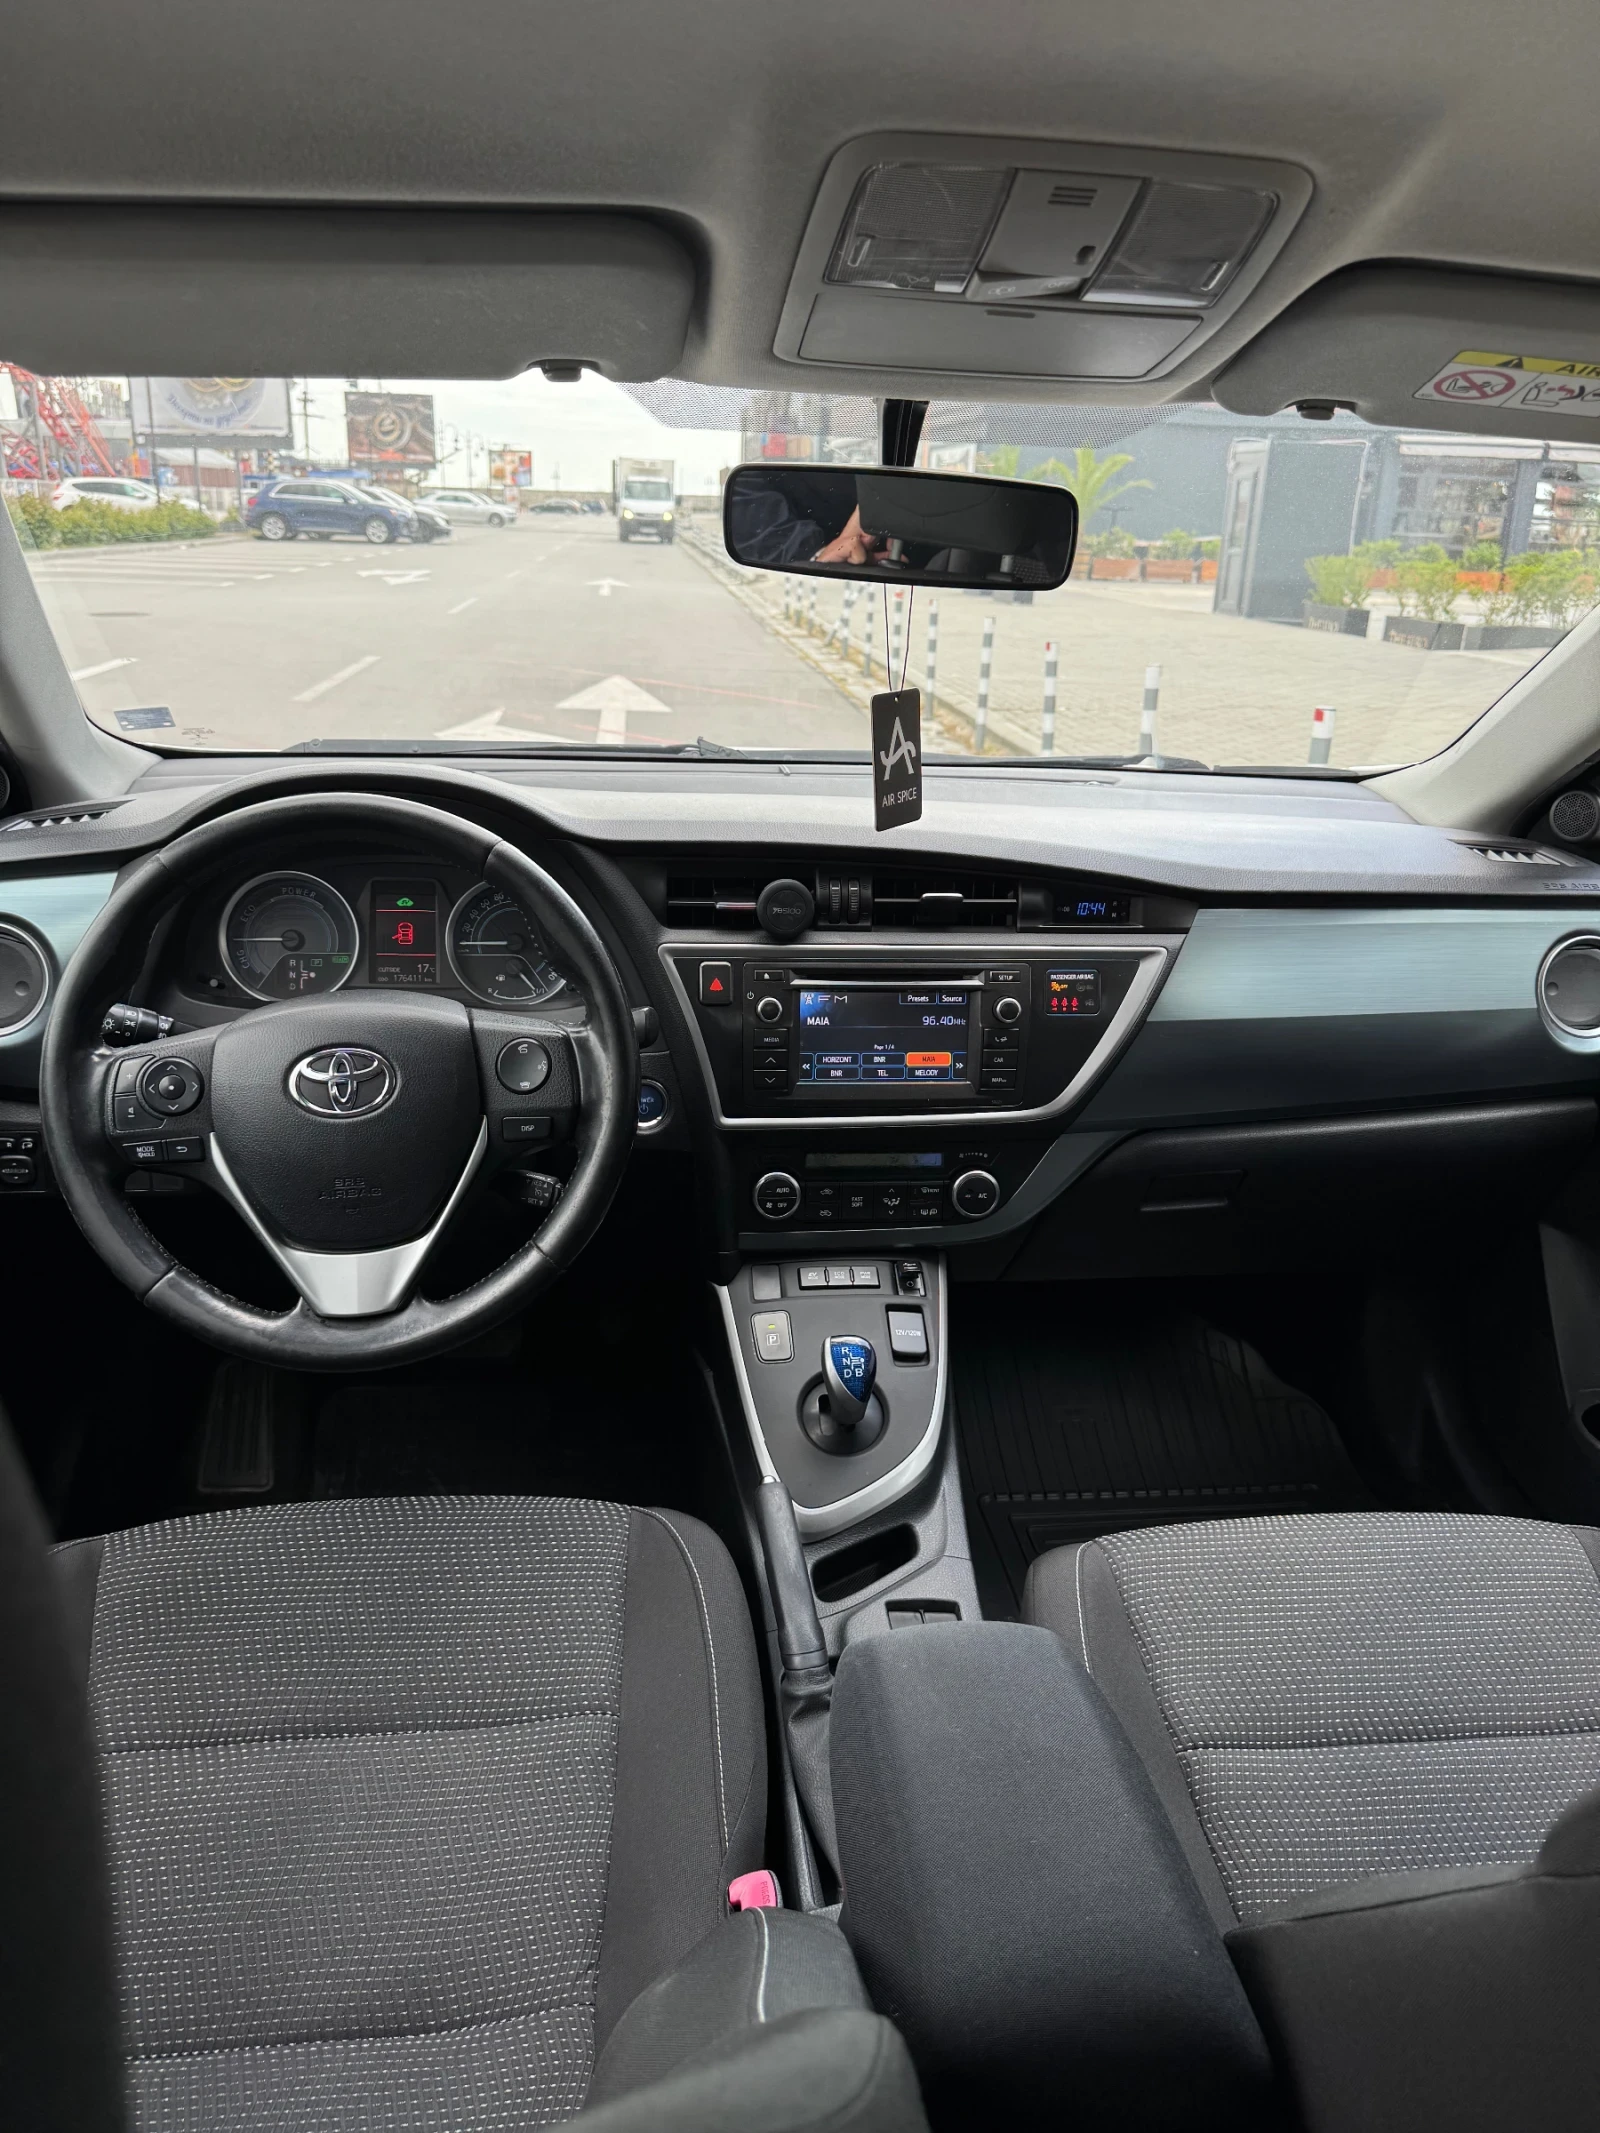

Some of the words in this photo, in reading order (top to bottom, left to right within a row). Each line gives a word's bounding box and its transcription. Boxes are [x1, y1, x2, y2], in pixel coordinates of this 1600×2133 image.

[882, 794, 895, 807] AIR
[897, 787, 917, 803] SPICE
[281, 886, 317, 899] POWER
[240, 904, 256, 922] ECO
[1077, 902, 1106, 915] 10:44
[469, 909, 479, 921] 40
[462, 922, 472, 933] 20
[417, 963, 429, 973] 17
[394, 974, 422, 982] 176411
[817, 994, 848, 1004] FM
[908, 994, 929, 1002] Presets
[942, 994, 963, 1002] Source
[807, 1016, 830, 1026] MAIA
[830, 1069, 843, 1077] BNR
[914, 1069, 939, 1077] MELODY
[521, 1124, 535, 1132] DISP
[136, 1145, 155, 1153] MODE
[334, 1177, 365, 1187] SRS
[318, 1187, 382, 1200] AIRBAG
[775, 1186, 790, 1194] AUTO
[977, 1192, 988, 1200] A/C
[769, 1335, 777, 1344] P
[841, 1346, 850, 1354] R
[843, 1357, 851, 1366] N
[844, 1369, 852, 1378] D
[855, 1368, 864, 1377] B
